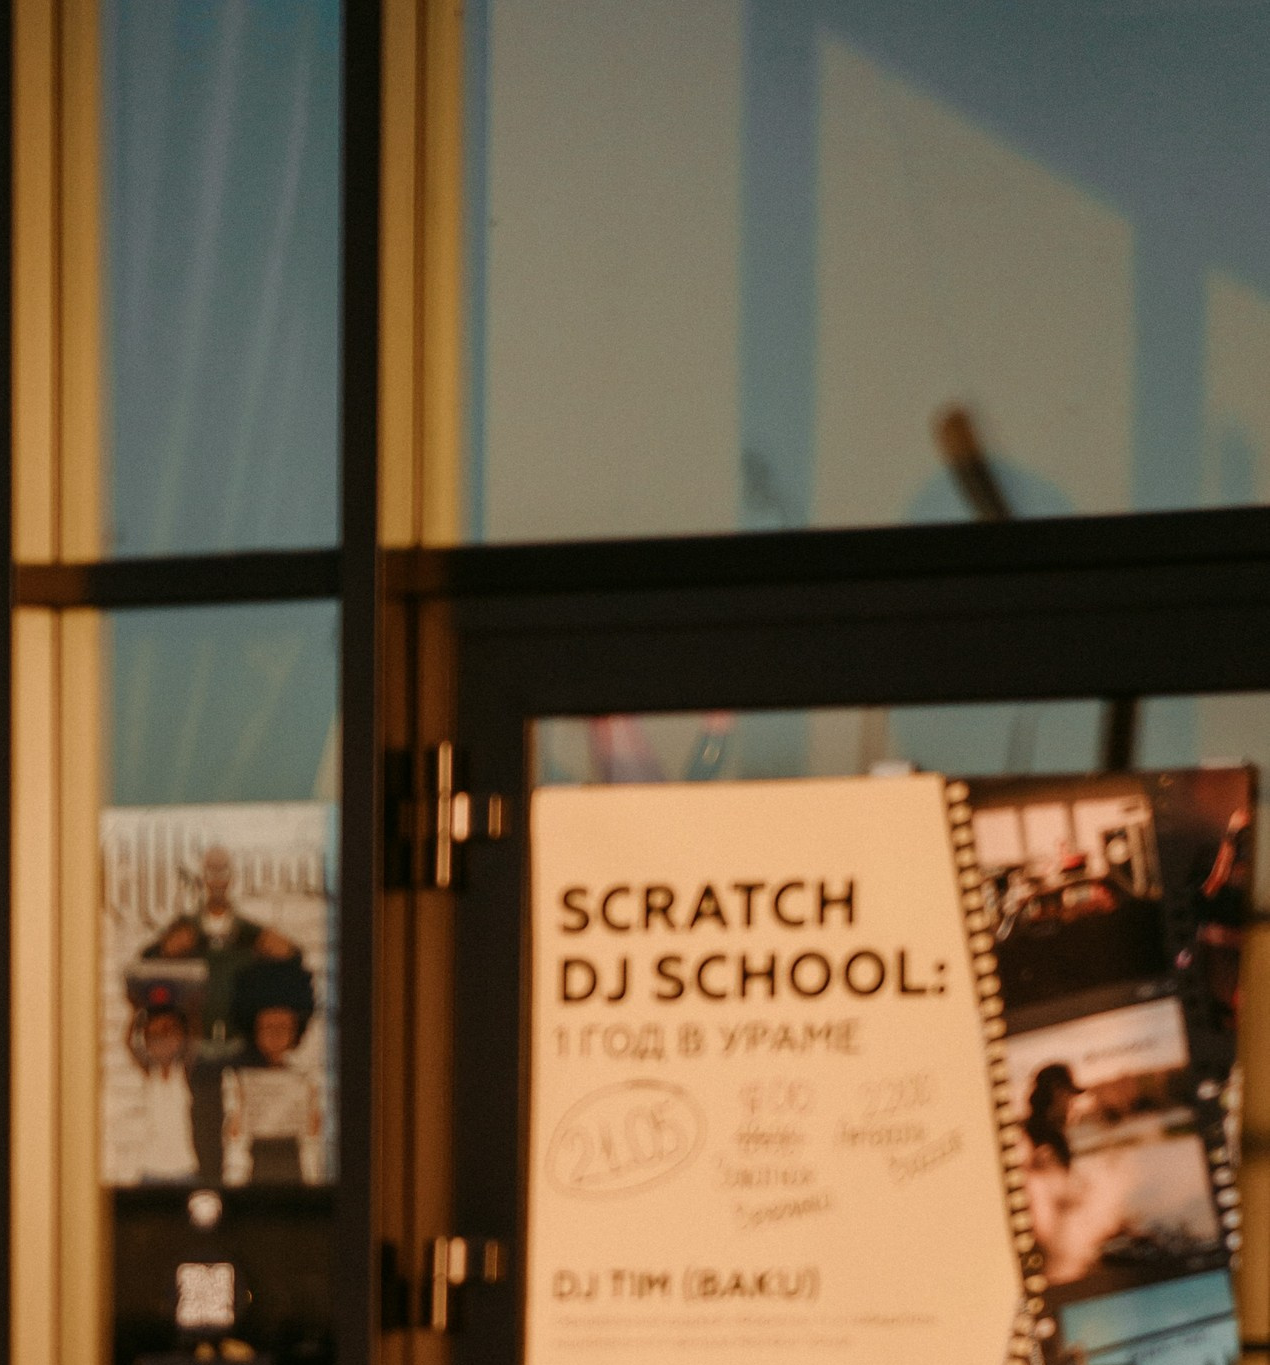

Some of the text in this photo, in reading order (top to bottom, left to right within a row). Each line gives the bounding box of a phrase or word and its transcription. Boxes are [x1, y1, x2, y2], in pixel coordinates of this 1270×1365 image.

[560, 876, 857, 934] SCRATCH
[561, 948, 948, 1003] DJ SCHOOL:
[577, 1021, 666, 1061] ГОД
[717, 1014, 864, 1059] УРАМЕ
[551, 1267, 599, 1301] DJ
